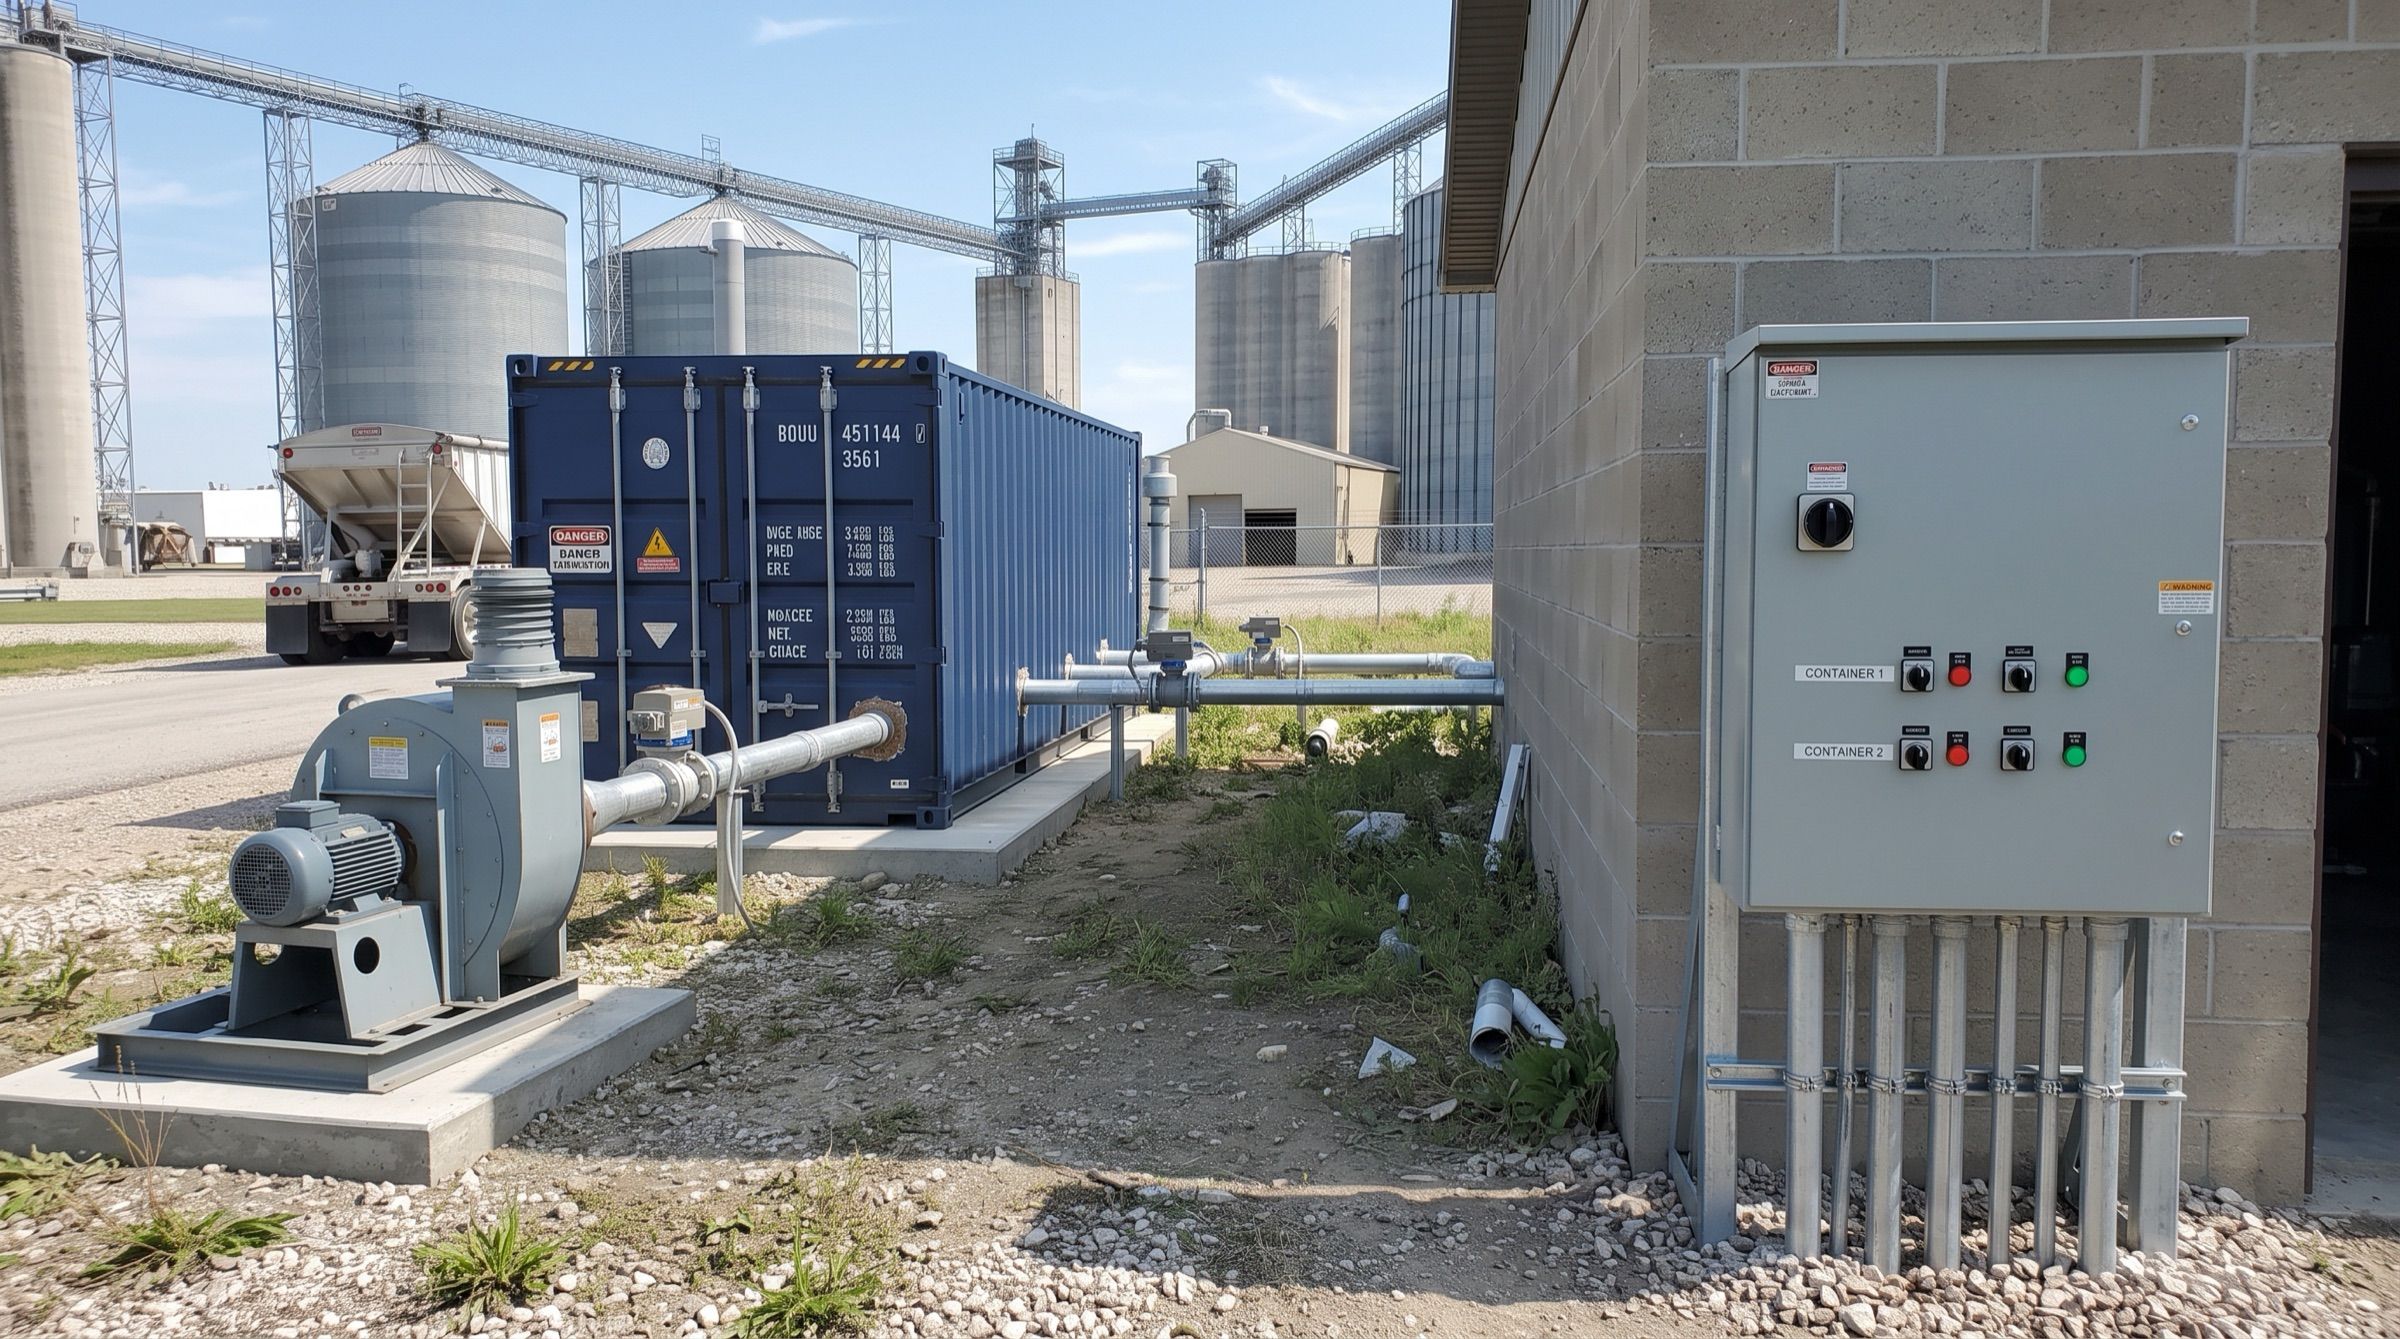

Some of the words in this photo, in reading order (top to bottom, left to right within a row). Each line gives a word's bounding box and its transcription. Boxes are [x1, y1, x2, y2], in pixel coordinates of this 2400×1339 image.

[778, 424, 817, 443] BOUU
[842, 424, 900, 443] 451144
[842, 450, 880, 468] 3561
[1805, 667, 1875, 679] CONTAINER
[1879, 668, 1883, 679] 1
[1804, 745, 1874, 758] CONTAINER
[1876, 747, 1884, 758] 2
